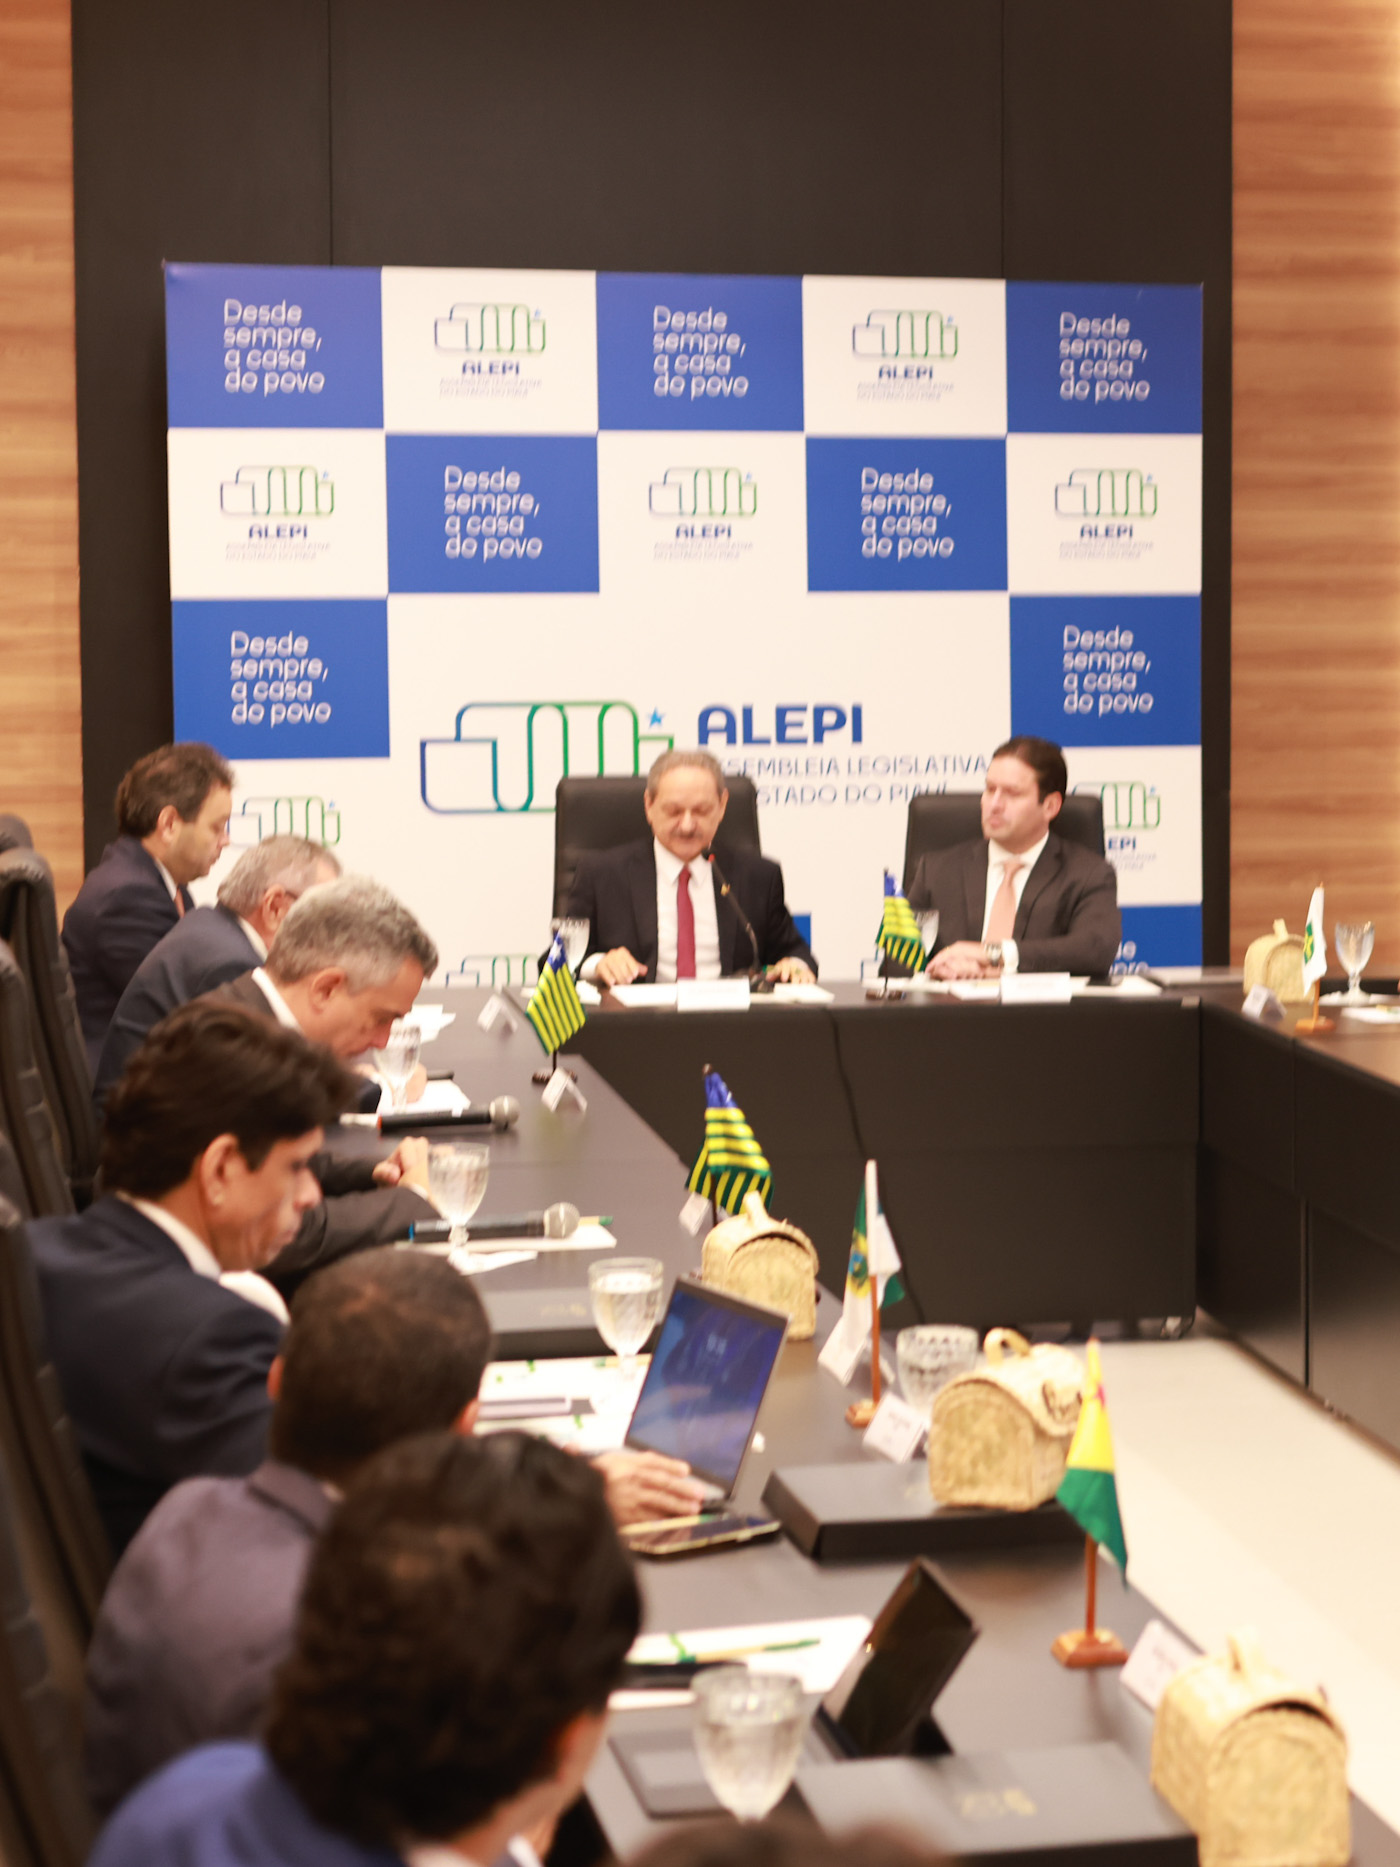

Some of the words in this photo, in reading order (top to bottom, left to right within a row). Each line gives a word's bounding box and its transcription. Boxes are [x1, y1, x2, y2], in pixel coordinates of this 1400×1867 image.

[224, 299, 302, 326] Desde
[653, 305, 728, 332] Desde
[1060, 311, 1130, 338] Desde
[224, 327, 322, 352] sempre,
[653, 332, 746, 358] sempre,
[1060, 338, 1148, 363] sempre,
[224, 349, 241, 370] a
[246, 349, 306, 371] casa
[461, 360, 519, 375] ALEPI
[653, 354, 669, 374] a
[674, 354, 731, 375] casa
[879, 364, 933, 379] ALEPI
[1060, 359, 1075, 379] a
[1079, 359, 1133, 380] casa
[225, 366, 258, 393] do
[264, 371, 325, 397] povo
[654, 370, 685, 397] do
[691, 376, 749, 401] povo
[1060, 374, 1090, 400] do
[1095, 380, 1150, 404] povo
[445, 465, 520, 492] Desde
[861, 467, 934, 493] Desde
[445, 493, 540, 518] sempre,
[861, 494, 952, 519] sempre,
[249, 522, 307, 538] ALEPI
[445, 515, 460, 536] a
[466, 515, 524, 537] casa
[676, 523, 731, 538] ALEPI
[862, 515, 876, 536] a
[882, 515, 937, 537] casa
[1080, 523, 1133, 538] ALEPI
[446, 532, 477, 558] do
[484, 537, 542, 563] povo
[862, 532, 892, 558] do
[898, 537, 955, 562] povo
[231, 630, 309, 657] Desde
[1063, 624, 1134, 651] Desde
[231, 658, 328, 682] sempre,
[1063, 651, 1151, 674] sempre,
[231, 680, 248, 702] a
[253, 680, 312, 702] casa
[1063, 672, 1078, 693] a
[1083, 672, 1137, 693] casa
[232, 698, 265, 725] do
[271, 702, 331, 728] povo
[1064, 689, 1094, 714] do
[1099, 692, 1154, 718] povo
[698, 703, 863, 745] ALEPI
[723, 756, 840, 777] SEMBLEIA
[847, 754, 988, 777] LEGISLATIVA
[756, 784, 838, 806] STADO
[845, 783, 882, 805] DO
[1107, 835, 1136, 851] EPI
